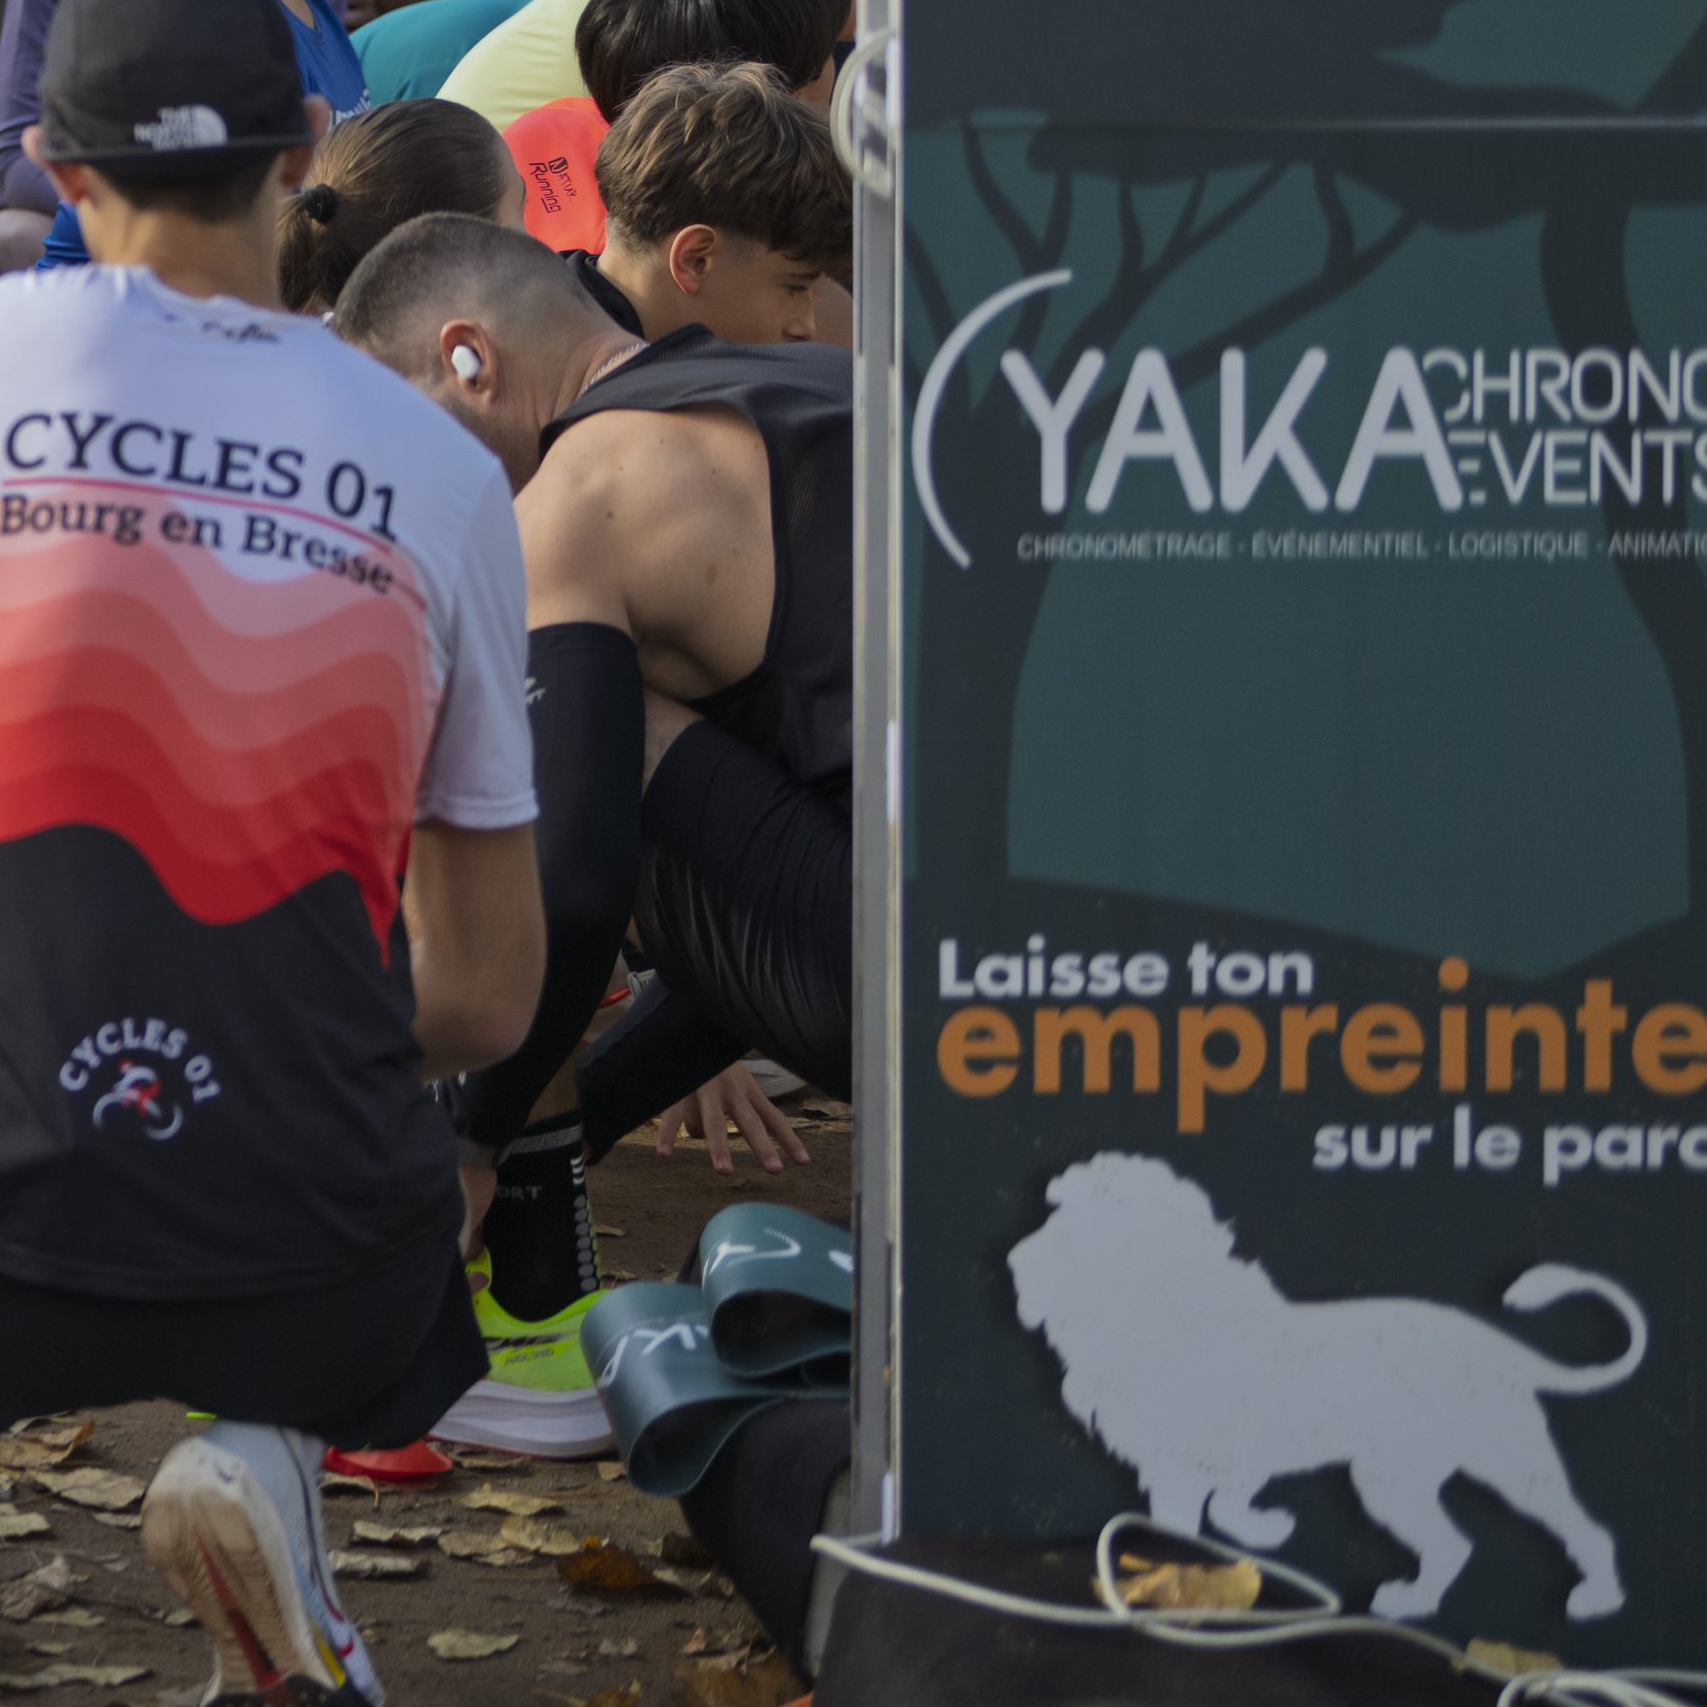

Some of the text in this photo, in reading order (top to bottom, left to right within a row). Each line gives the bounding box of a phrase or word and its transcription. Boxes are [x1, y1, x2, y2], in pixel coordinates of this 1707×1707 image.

[528, 162, 562, 213] Running
[999, 344, 1464, 516] YAKA
[3, 409, 399, 544] CYCLES 01
[159, 510, 225, 550] en
[239, 512, 396, 595] Bresse
[1017, 527, 1232, 561] CHRONOMÉTRAGE
[1251, 527, 1429, 561] ÉVÉNEMENTIEL
[1447, 529, 1589, 564] LOGISTIQUE
[939, 933, 1316, 997] Laisse ton
[59, 1017, 189, 1093] CYCLES
[935, 955, 1707, 1135] empreinte
[1312, 1101, 1707, 1188] sur le parc
